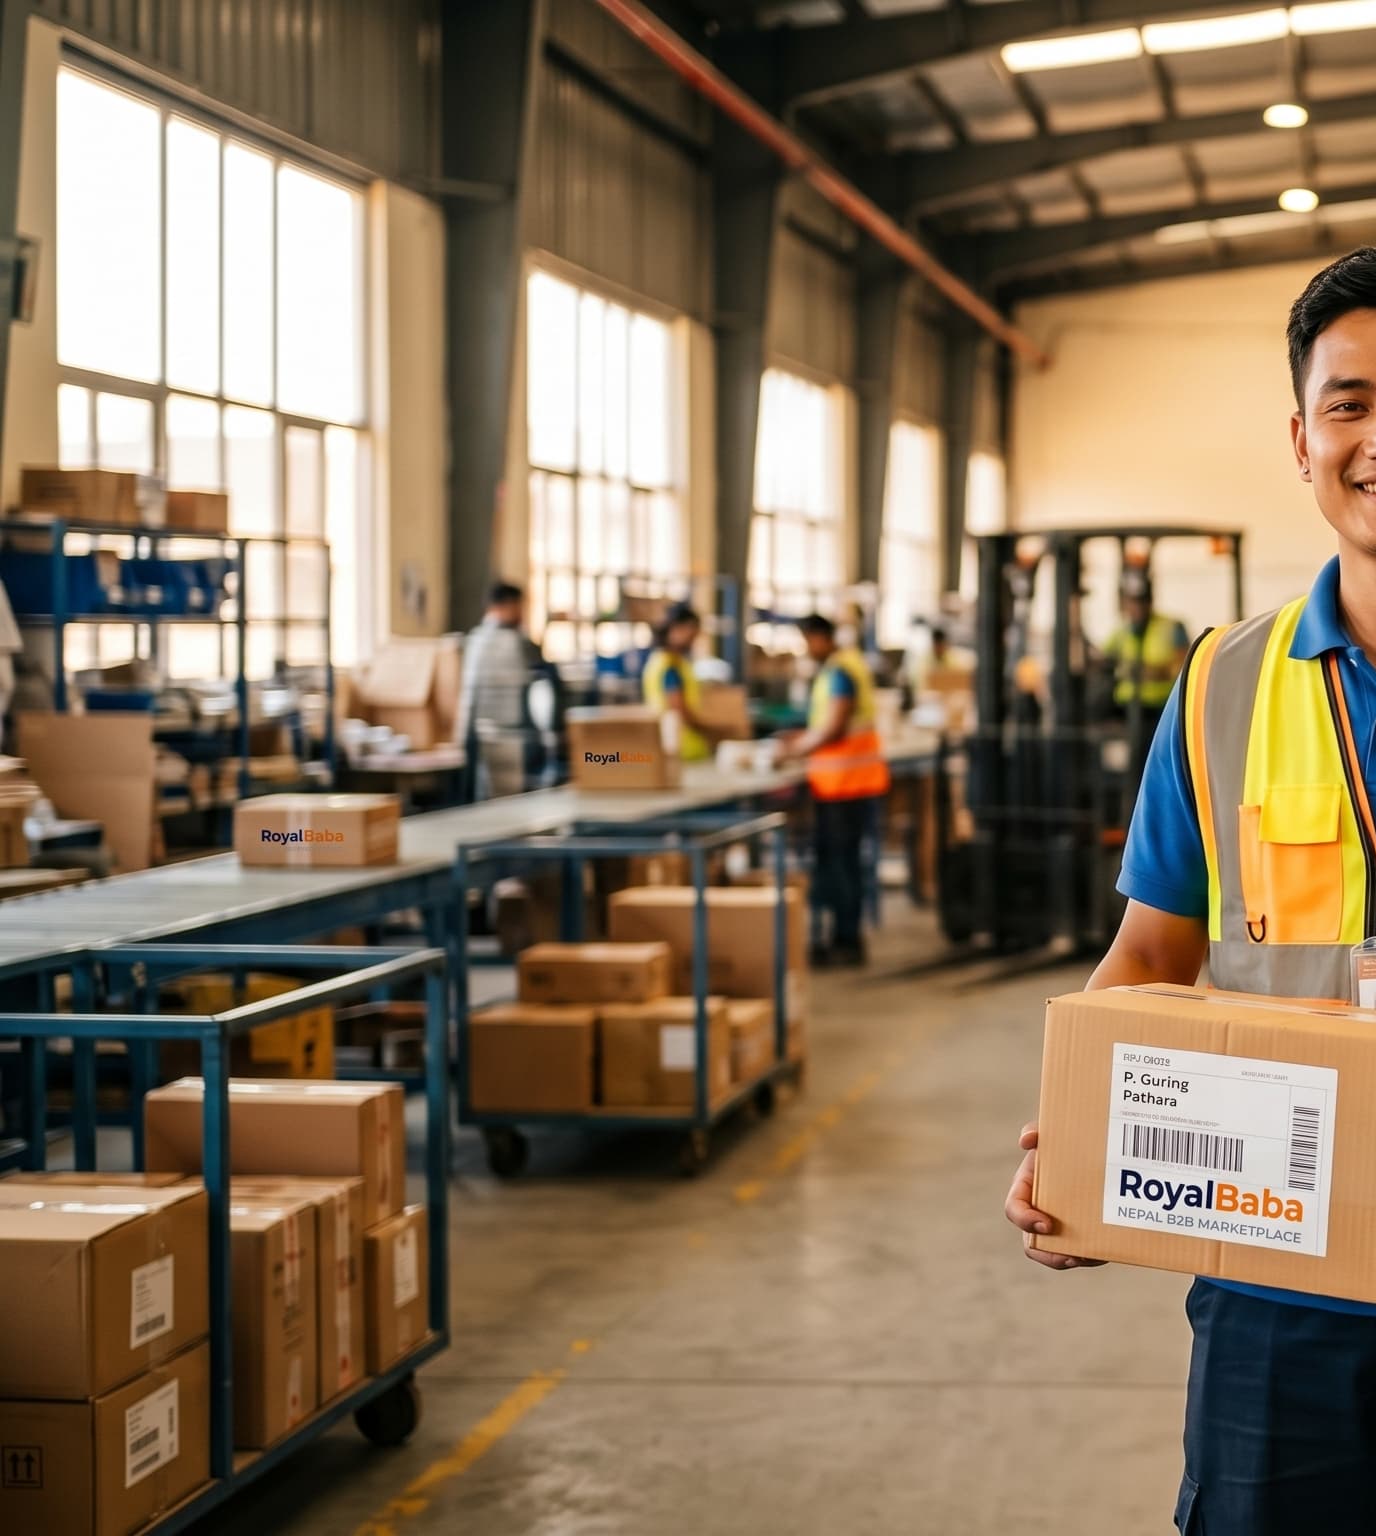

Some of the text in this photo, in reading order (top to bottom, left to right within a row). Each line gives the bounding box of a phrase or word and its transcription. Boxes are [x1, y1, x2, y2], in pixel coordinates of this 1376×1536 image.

[261, 829, 345, 846] RoyalBaba
[1124, 1071, 1190, 1094] P. Guring
[1123, 1089, 1178, 1107] Pathara
[1119, 1168, 1304, 1223] RoyalBaba
[1117, 1206, 1302, 1244] NEPAL B2B MARKETPLACE
